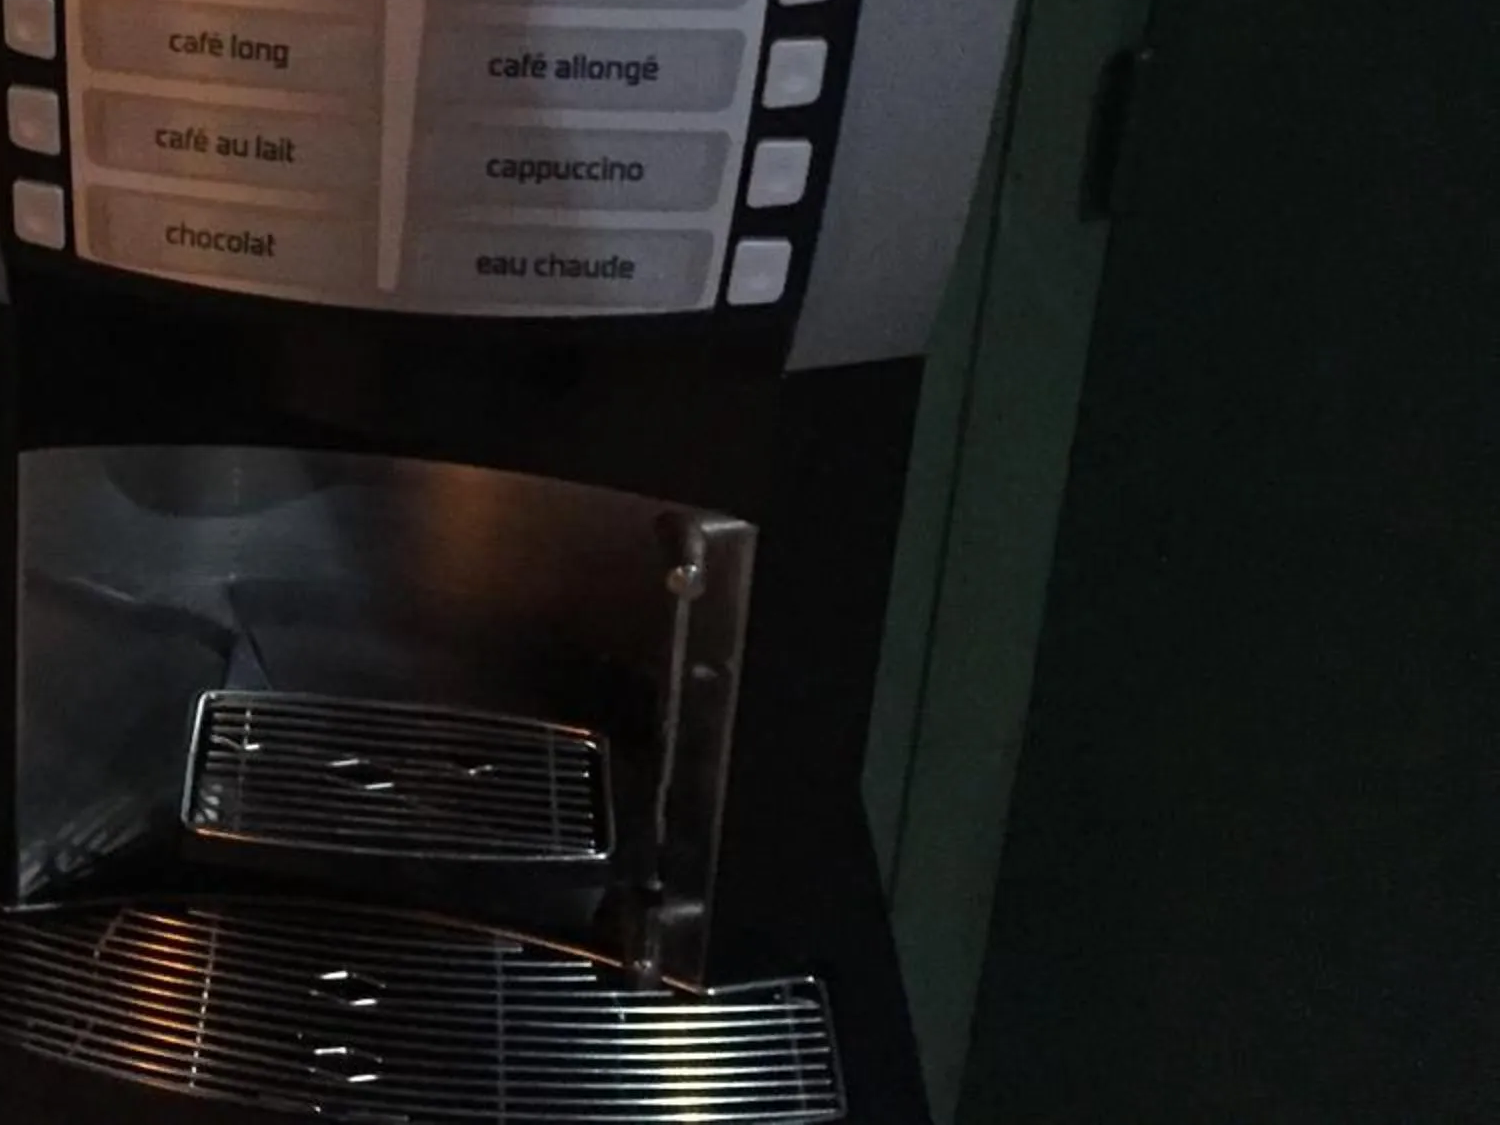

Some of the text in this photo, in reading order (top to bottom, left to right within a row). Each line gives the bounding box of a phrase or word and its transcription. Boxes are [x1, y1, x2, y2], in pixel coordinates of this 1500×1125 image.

[168, 31, 291, 69] café long
[487, 54, 660, 87] café allongé
[154, 127, 297, 165] café au lait
[485, 155, 646, 184] cappuccino
[165, 222, 277, 259] chocolat
[475, 253, 636, 280] eau chaude
